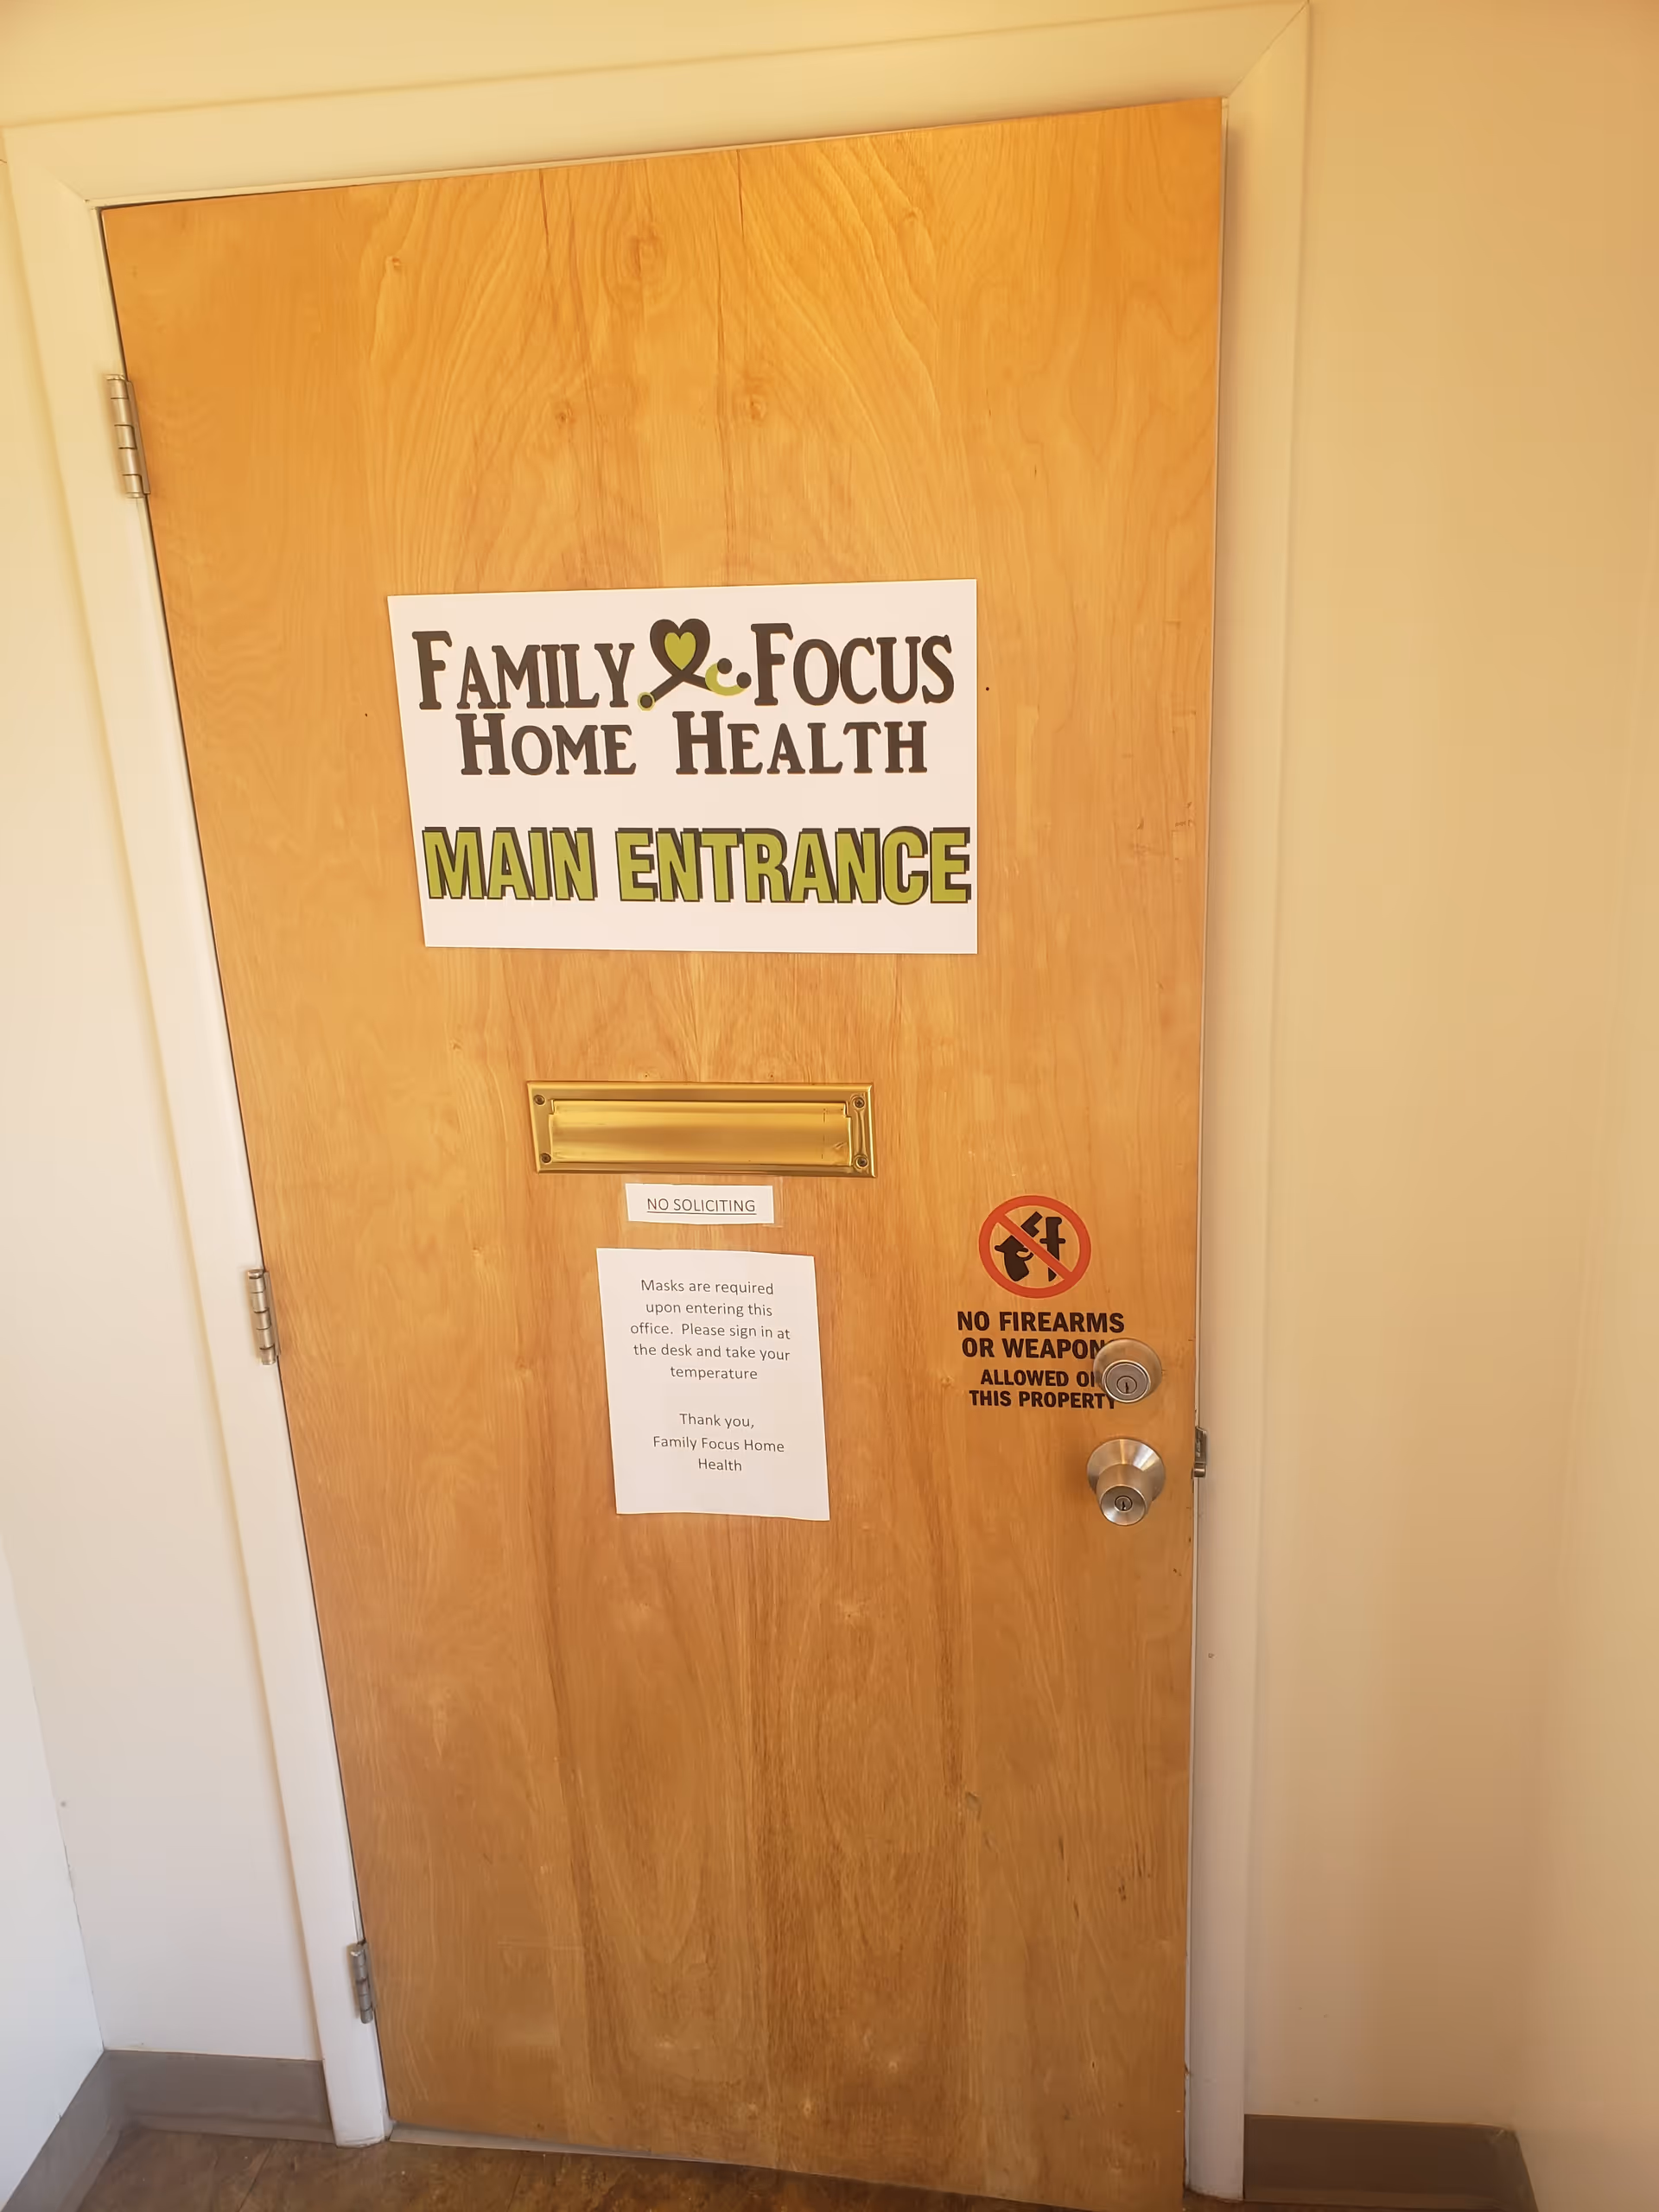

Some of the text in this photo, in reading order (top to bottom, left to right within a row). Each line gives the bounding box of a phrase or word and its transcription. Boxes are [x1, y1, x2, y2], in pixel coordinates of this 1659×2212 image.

[412, 623, 954, 709] FAMILY FOCUS
[455, 711, 927, 775] HOME HEALTH
[422, 825, 971, 906] MAIN ENTRANCE
[646, 1198, 755, 1212] NO SOLICITING
[640, 1279, 774, 1296] Masks are required
[645, 1302, 773, 1318] upon entering this
[630, 1321, 791, 1340] office. Please sign in at
[957, 1311, 1124, 1333] NO FIREARMS
[632, 1343, 791, 1362] the desk and take your
[962, 1338, 1115, 1358] OR WEAPON
[670, 1366, 758, 1381] temperature
[980, 1370, 1069, 1387] ALLOWED
[969, 1390, 1012, 1406] THIS
[678, 1413, 754, 1430] Thank you,
[653, 1435, 785, 1452] Family Focus Home
[697, 1458, 742, 1472] Health
